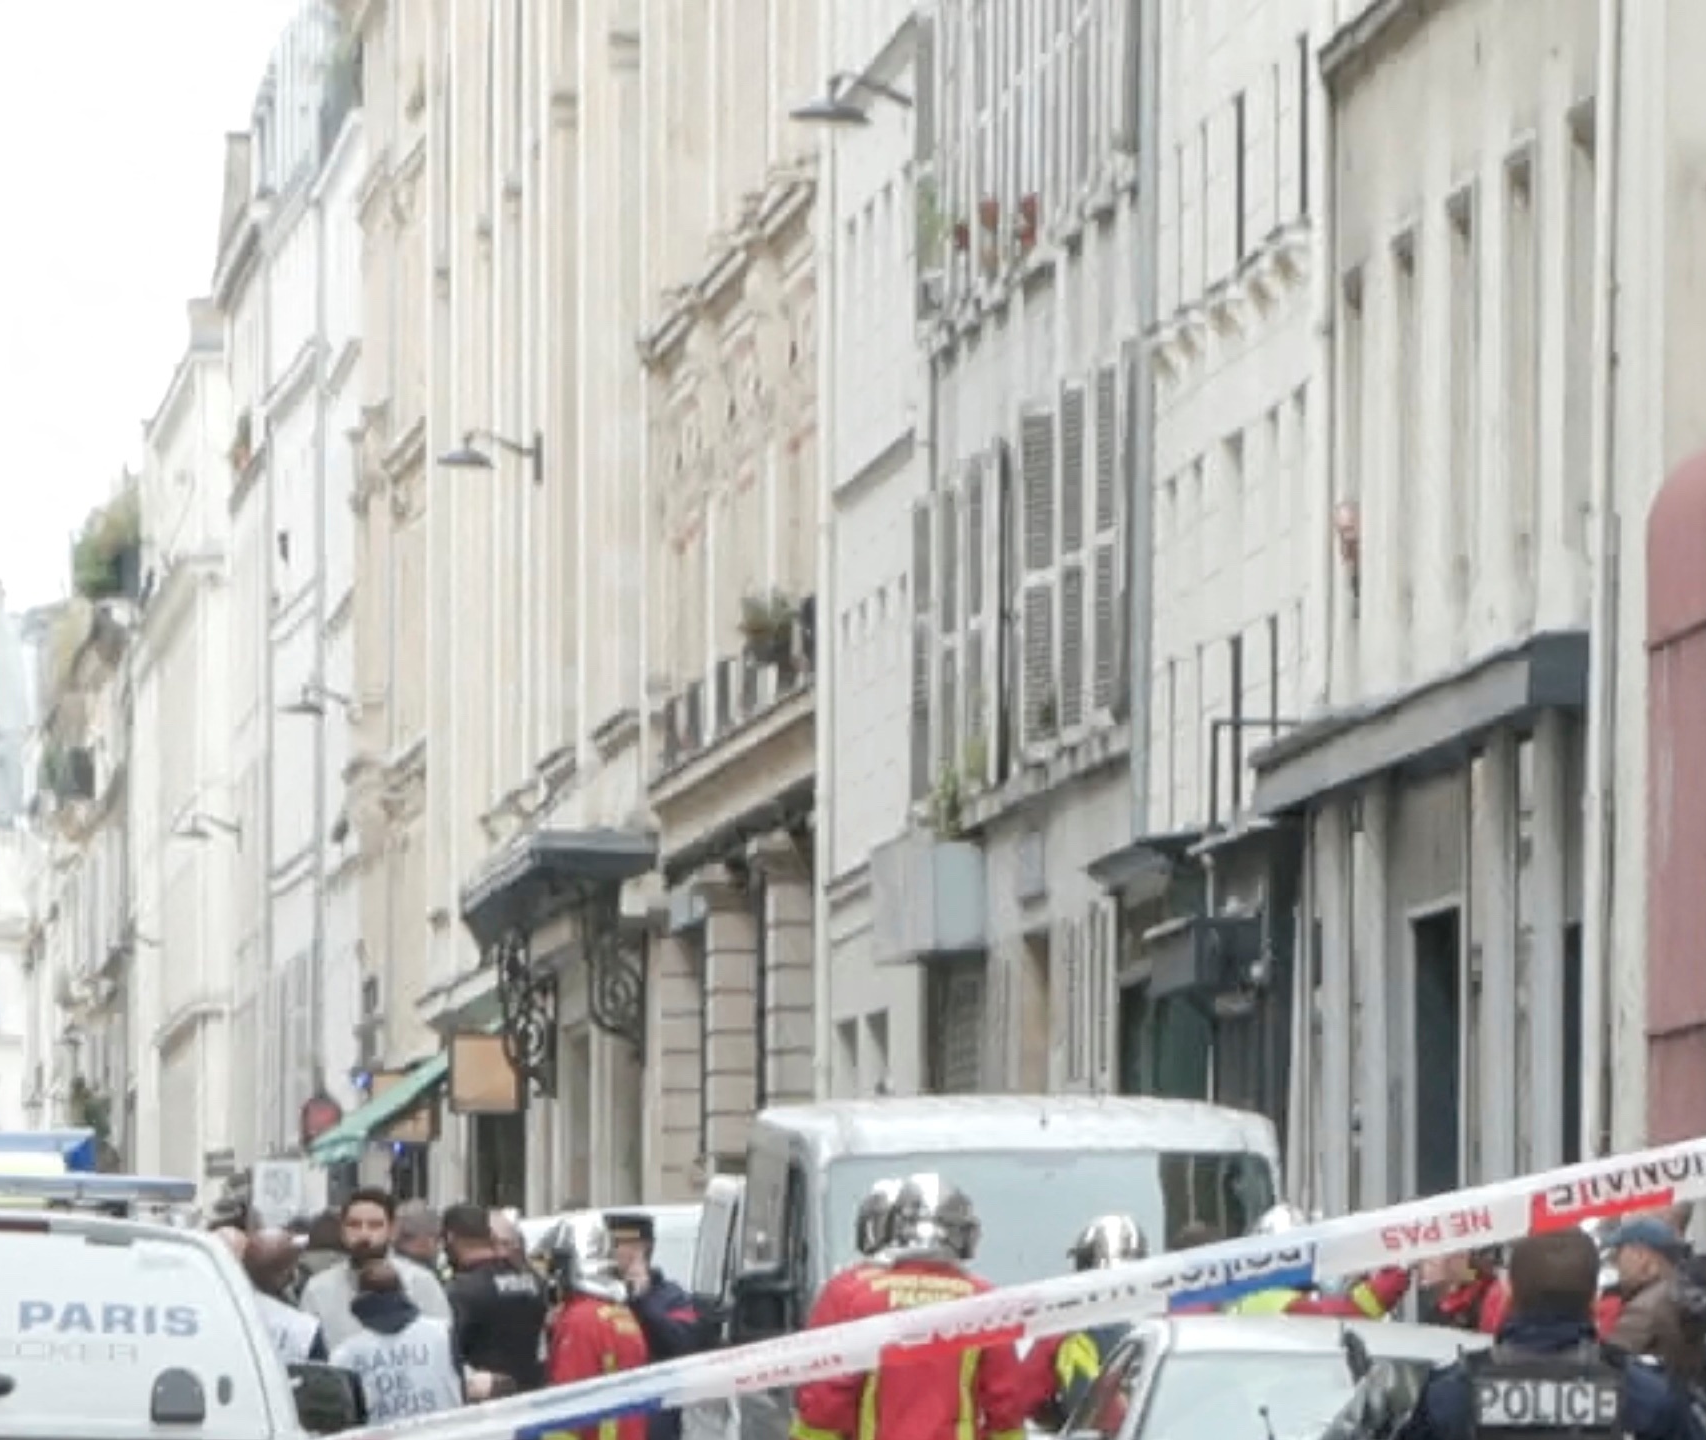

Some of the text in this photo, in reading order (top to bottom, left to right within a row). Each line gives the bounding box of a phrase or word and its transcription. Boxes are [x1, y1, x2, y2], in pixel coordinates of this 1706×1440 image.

[1382, 1204, 1494, 1251] NE PAS
[17, 1300, 202, 1337] PARIS
[1478, 1380, 1618, 1426] POLICE
